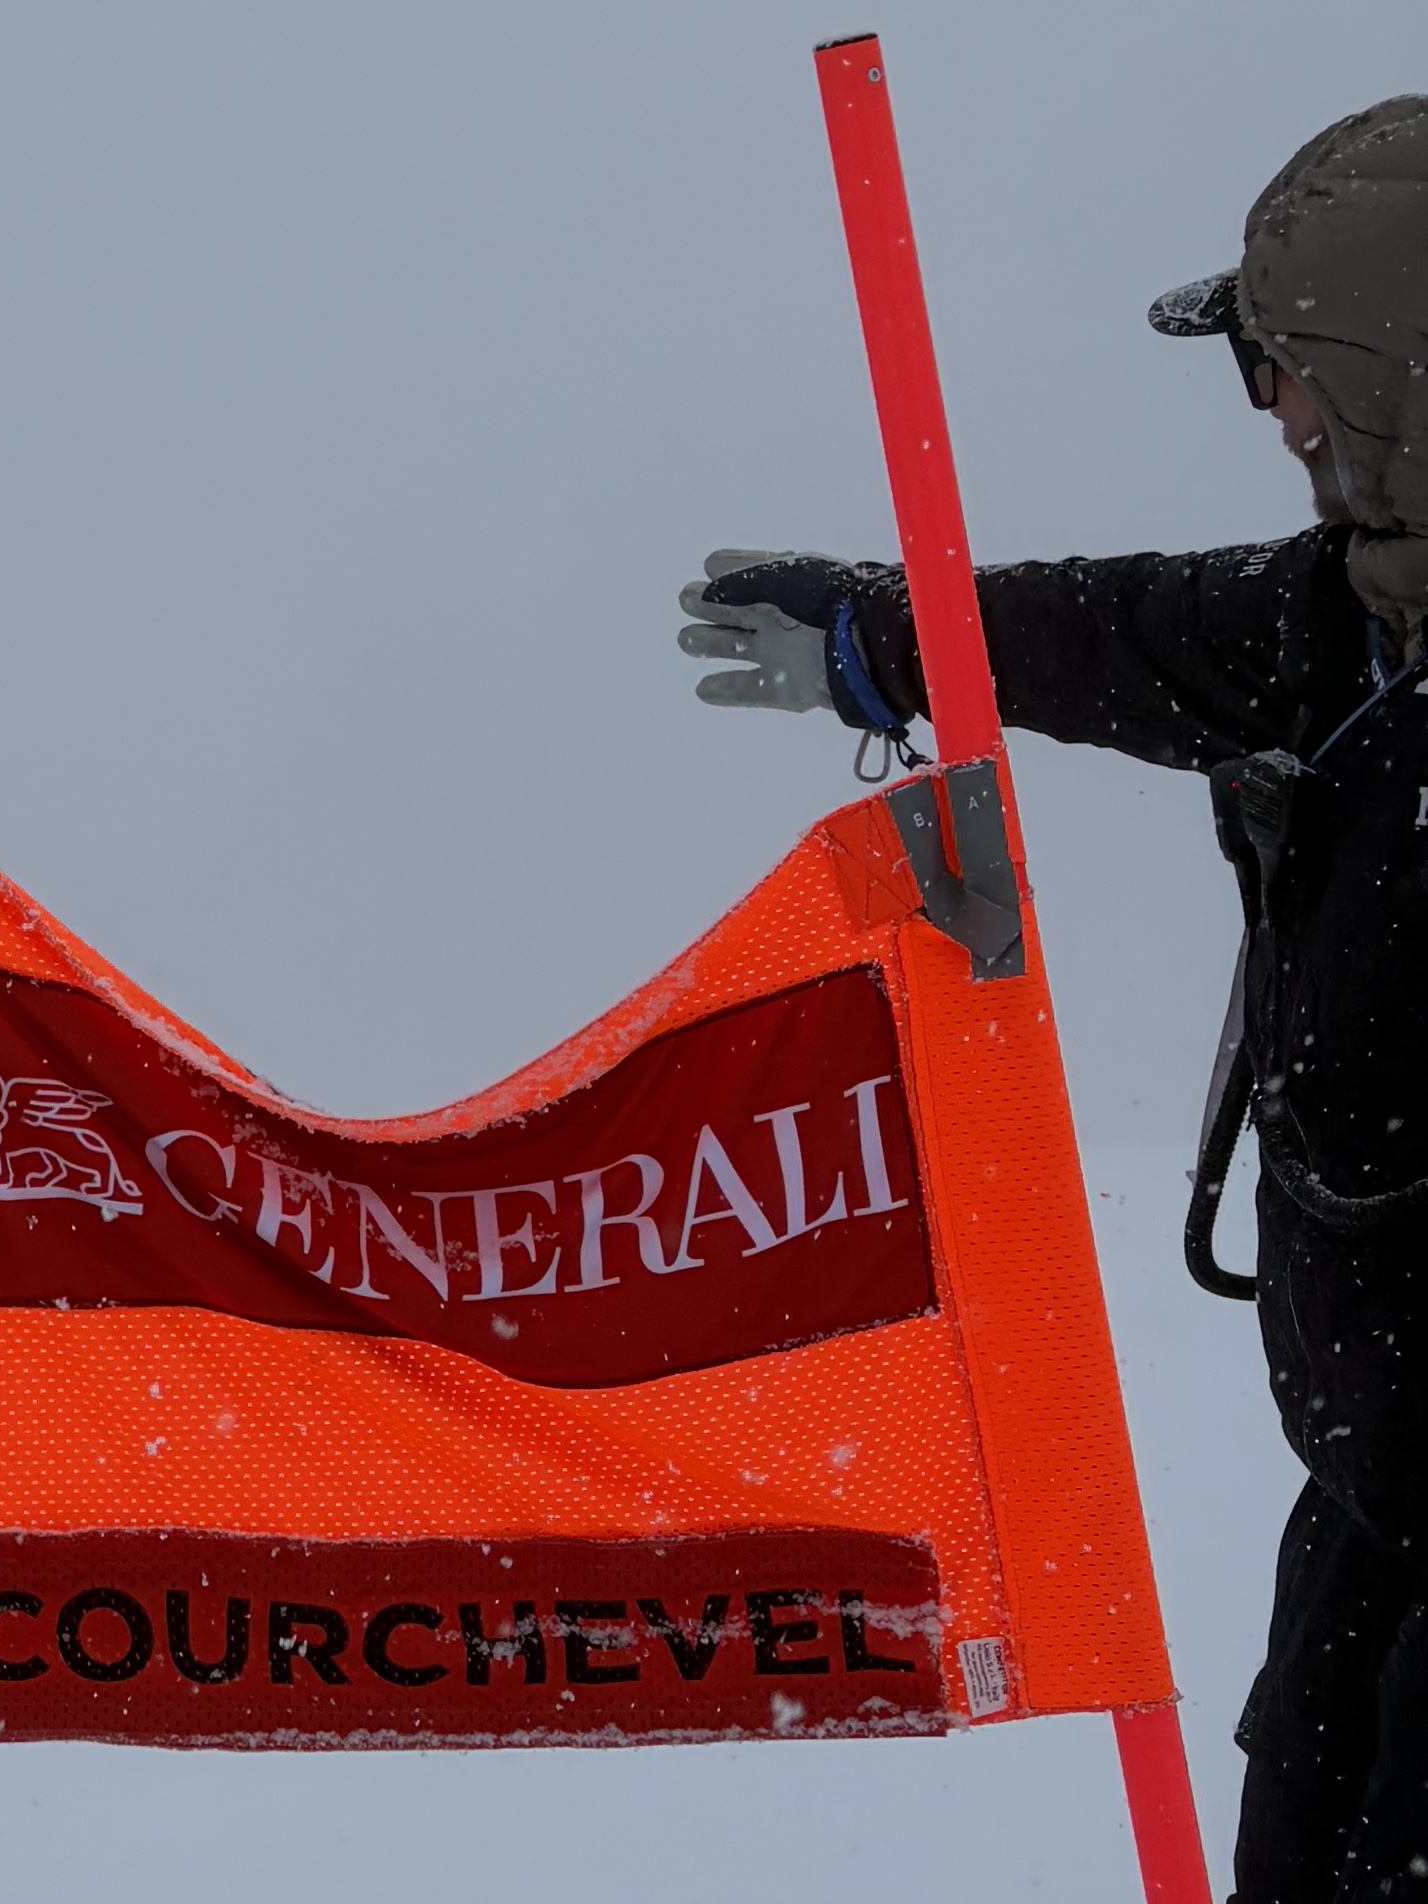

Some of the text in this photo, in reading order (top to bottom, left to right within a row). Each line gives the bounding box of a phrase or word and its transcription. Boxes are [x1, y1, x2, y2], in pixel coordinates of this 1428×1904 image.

[968, 796, 979, 810] A
[913, 812, 925, 828] B
[145, 1075, 909, 1302] GENERALI
